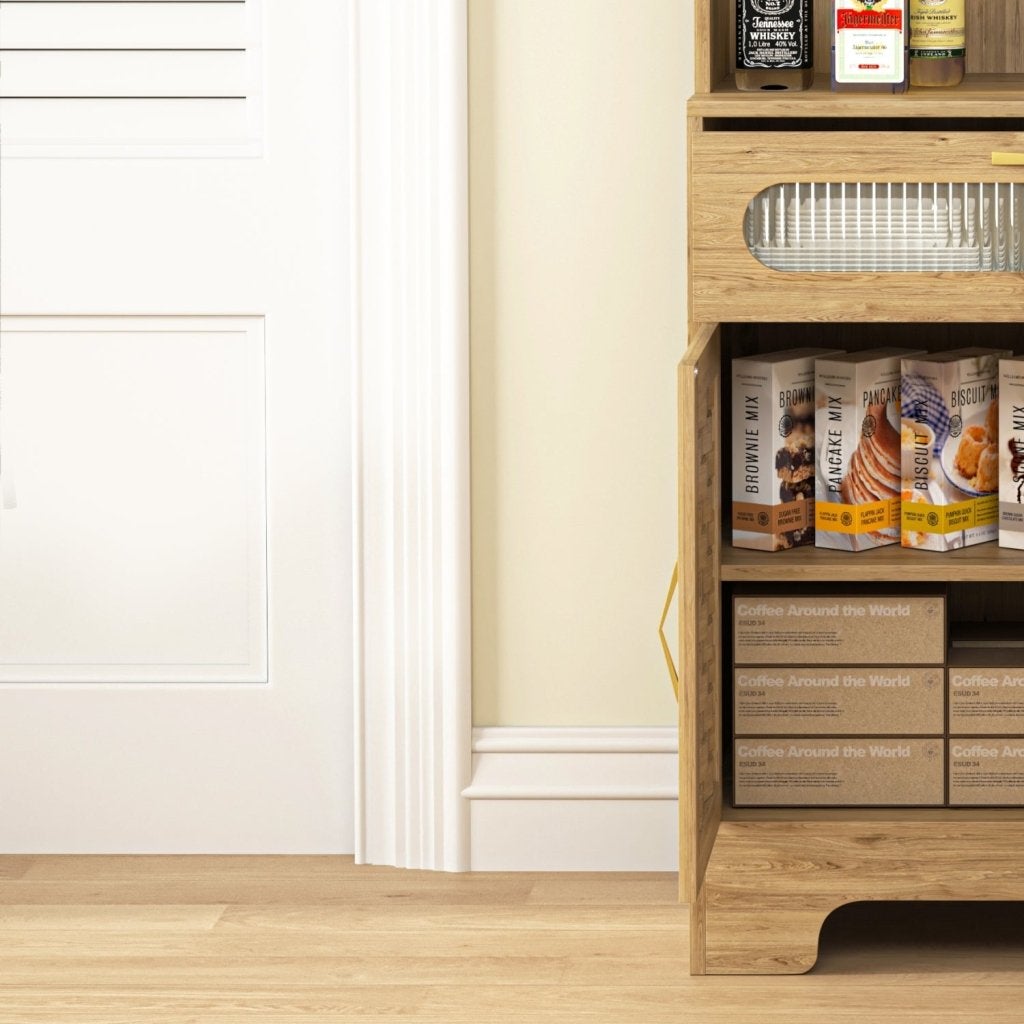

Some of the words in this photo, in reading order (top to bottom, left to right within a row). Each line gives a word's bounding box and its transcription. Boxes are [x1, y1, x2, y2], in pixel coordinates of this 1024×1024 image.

[752, 16, 794, 28] Tennessee
[750, 32, 796, 40] WHISKEY
[779, 385, 815, 408] BROWNI
[951, 385, 986, 408] BISCUIT
[745, 396, 759, 421] MIX
[828, 396, 842, 422] MIX
[915, 399, 928, 424] MIX
[745, 429, 759, 494] BROWNIE
[828, 429, 842, 494] PANCAKE
[915, 433, 928, 490] BISCUIT
[737, 605, 784, 617] Coffee
[787, 605, 839, 617] Around
[842, 605, 865, 617] the
[869, 605, 911, 617] World
[737, 675, 784, 687] Coffee
[787, 675, 839, 687] Around
[843, 675, 866, 687] the
[869, 675, 911, 687] World
[952, 675, 999, 687] Coffee
[737, 745, 784, 758] Coffee
[787, 745, 839, 758] Around
[843, 745, 866, 758] the
[869, 745, 911, 758] World
[952, 745, 999, 758] Coffee
